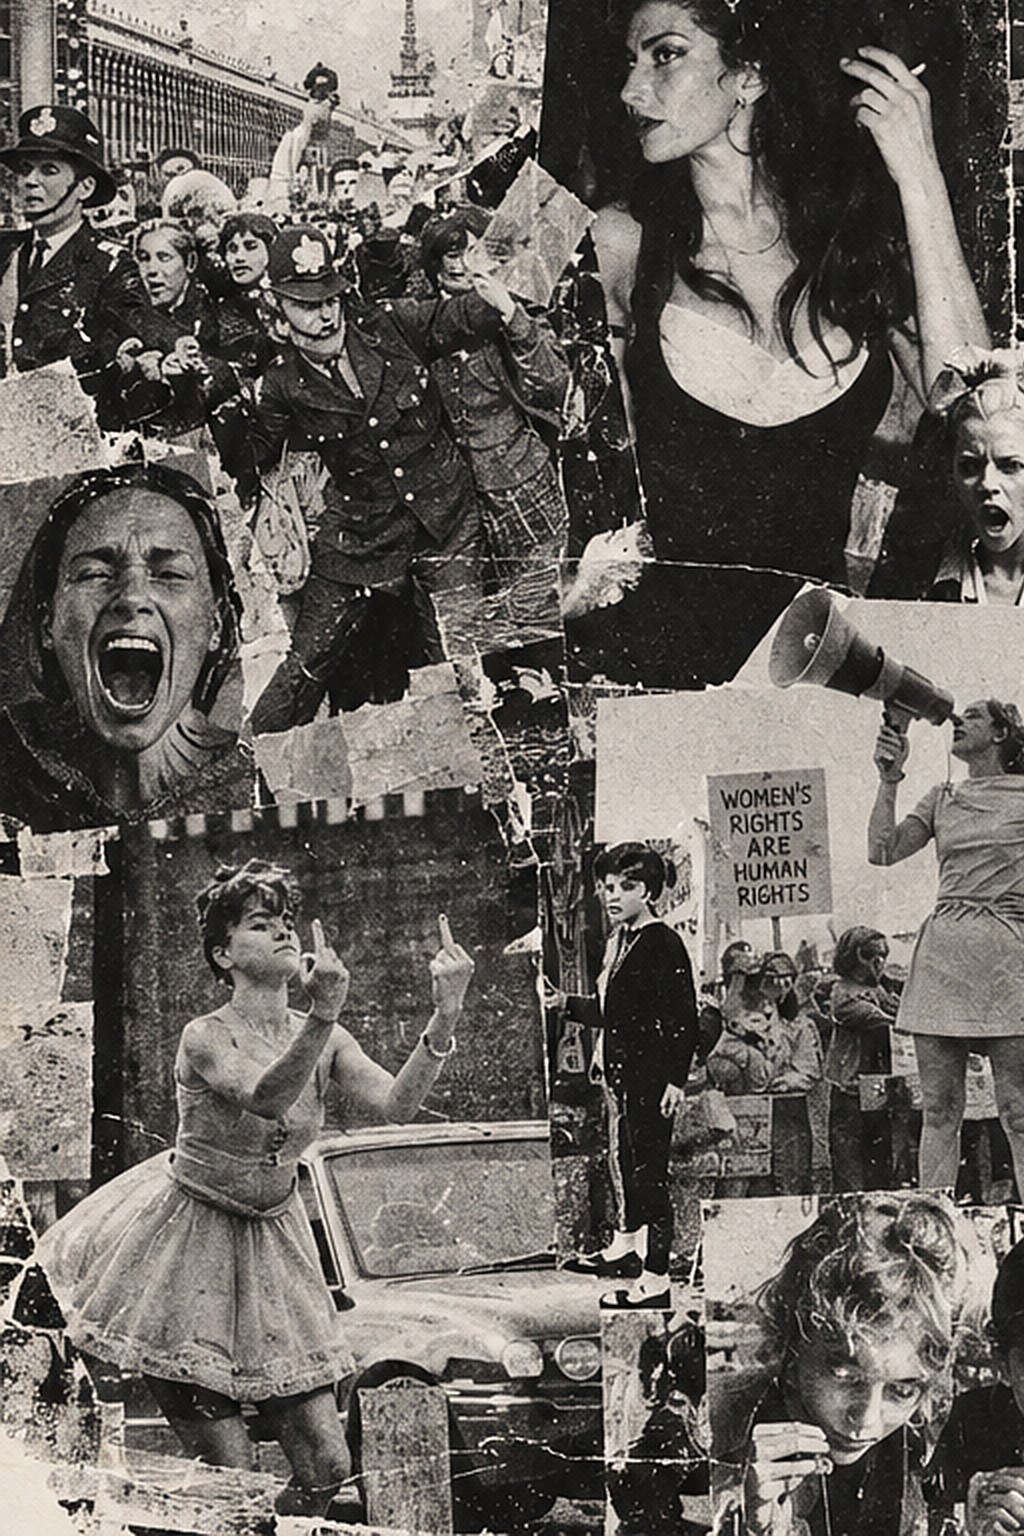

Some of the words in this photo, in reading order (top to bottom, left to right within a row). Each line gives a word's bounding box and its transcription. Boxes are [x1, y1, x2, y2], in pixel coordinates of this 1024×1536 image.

[720, 782, 812, 810] WOMEN'S
[730, 810, 803, 835] RIGHTS
[748, 836, 791, 858] ARE
[734, 858, 807, 882] HUMAN
[737, 884, 810, 907] RIGHTS
